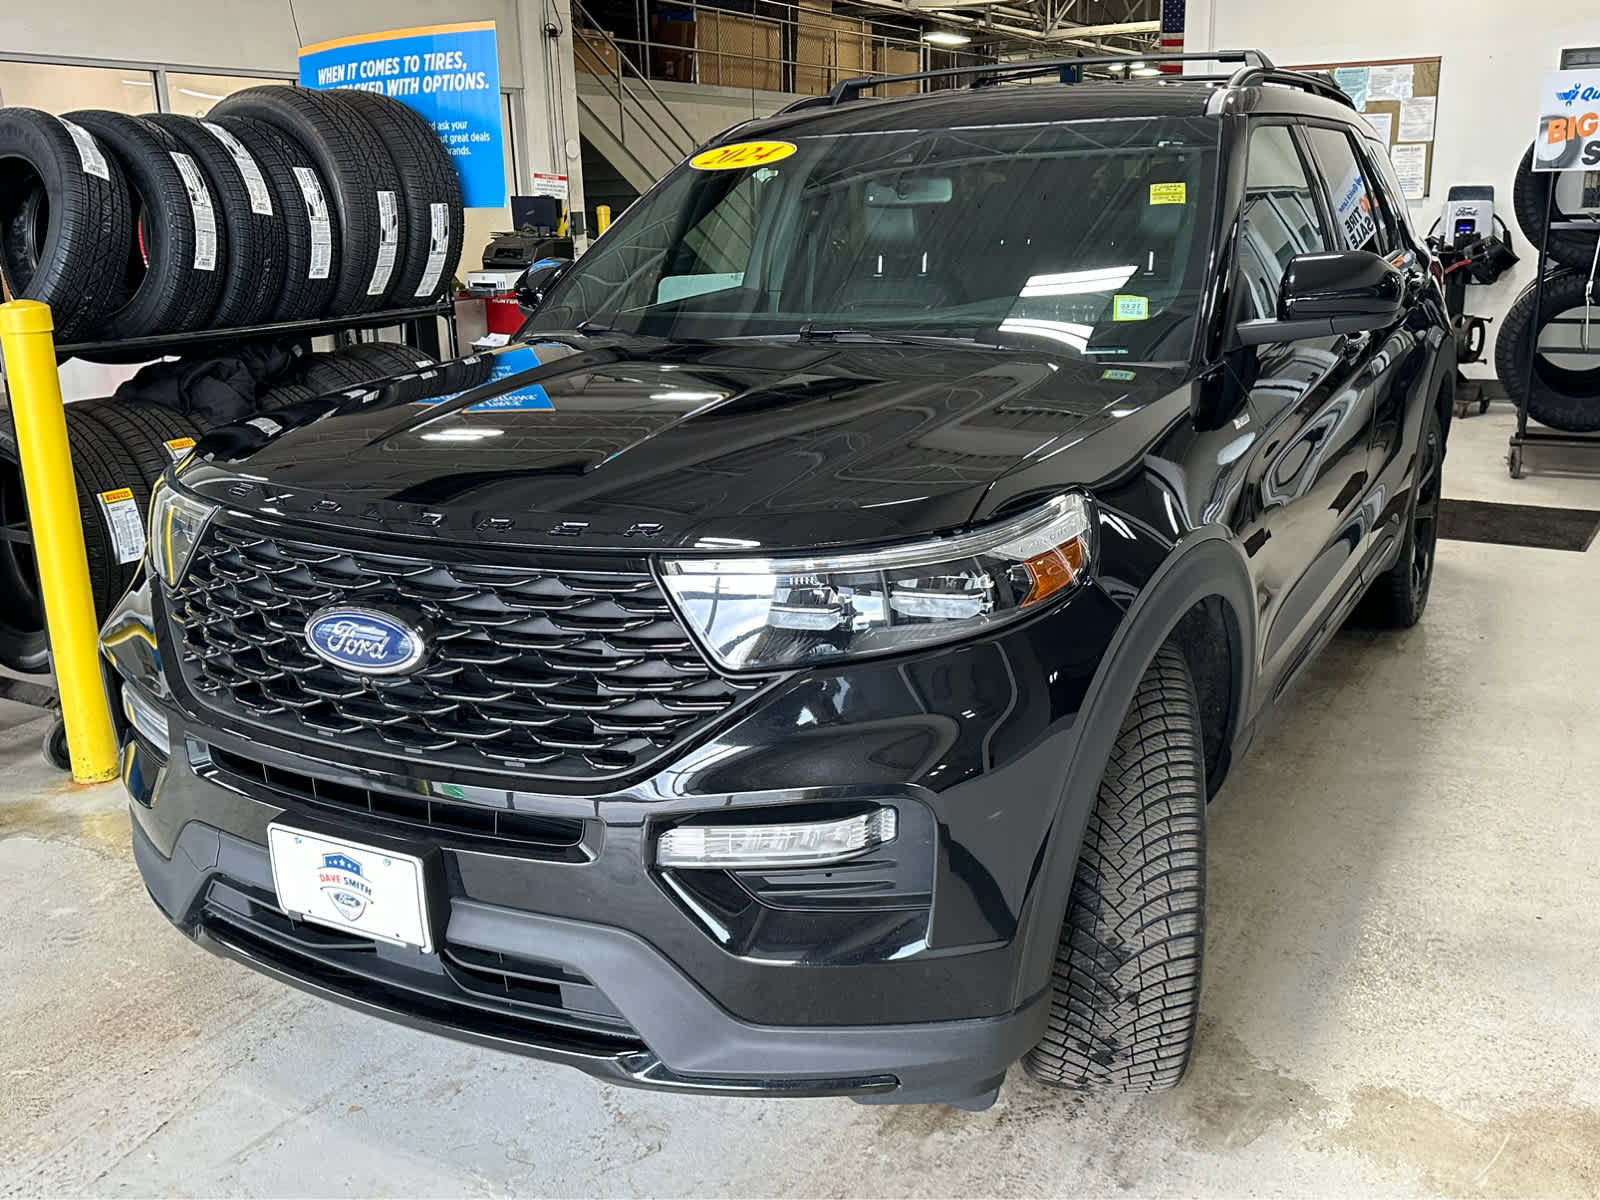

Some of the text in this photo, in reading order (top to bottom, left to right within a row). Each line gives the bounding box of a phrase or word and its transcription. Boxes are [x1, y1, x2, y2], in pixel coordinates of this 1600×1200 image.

[317, 51, 467, 86] WHEN IT COMES TO TIRES,
[386, 77, 420, 97] WITH
[422, 72, 490, 94] OPTIONS.
[437, 120, 449, 131] ask
[451, 121, 468, 132] your
[450, 133, 469, 144] great
[471, 131, 491, 142] deals
[1547, 112, 1599, 144] BIG
[700, 145, 785, 165] 2024
[326, 620, 391, 660] Ford
[319, 873, 372, 896] DAVE SMITH
